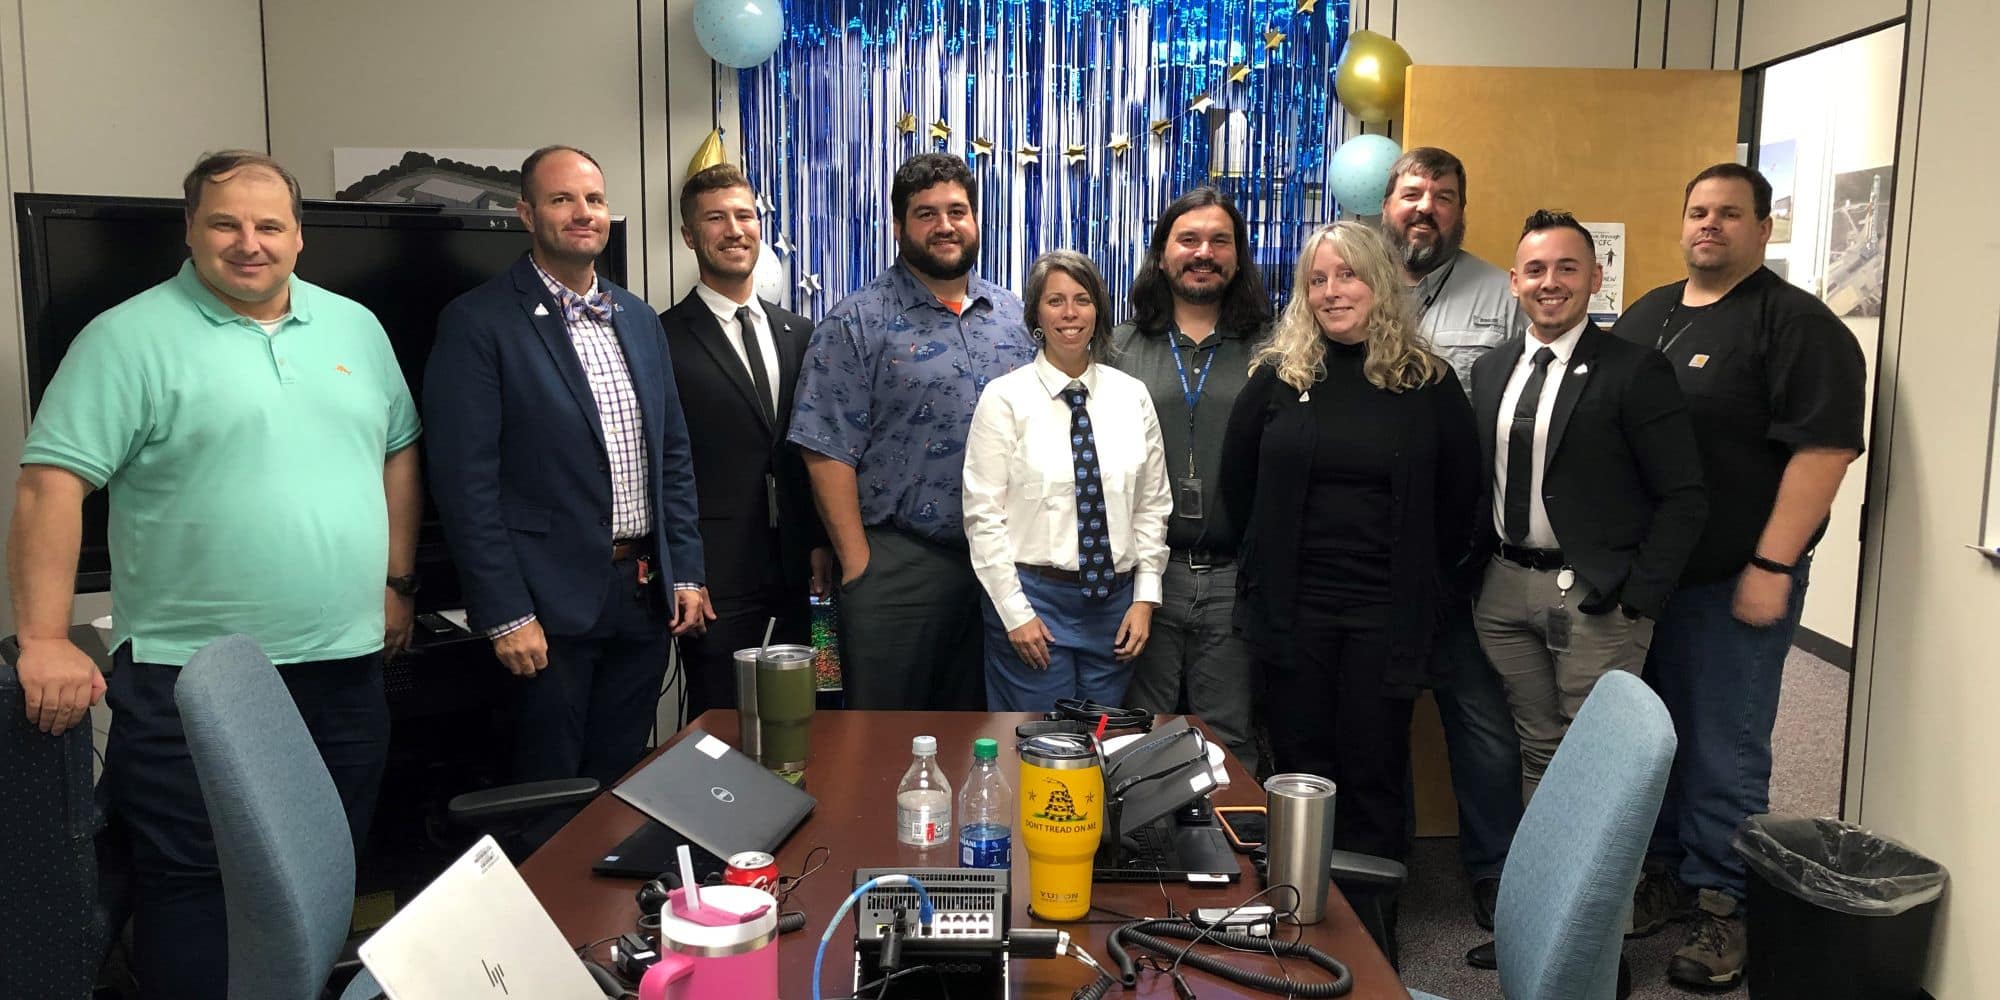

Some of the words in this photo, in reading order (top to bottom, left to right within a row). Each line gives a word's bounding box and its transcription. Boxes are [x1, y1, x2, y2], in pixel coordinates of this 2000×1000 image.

[1025, 819, 1043, 831] DONT
[1045, 825, 1072, 834] TREAD
[1074, 824, 1086, 833] ON
[1087, 821, 1097, 831] ME
